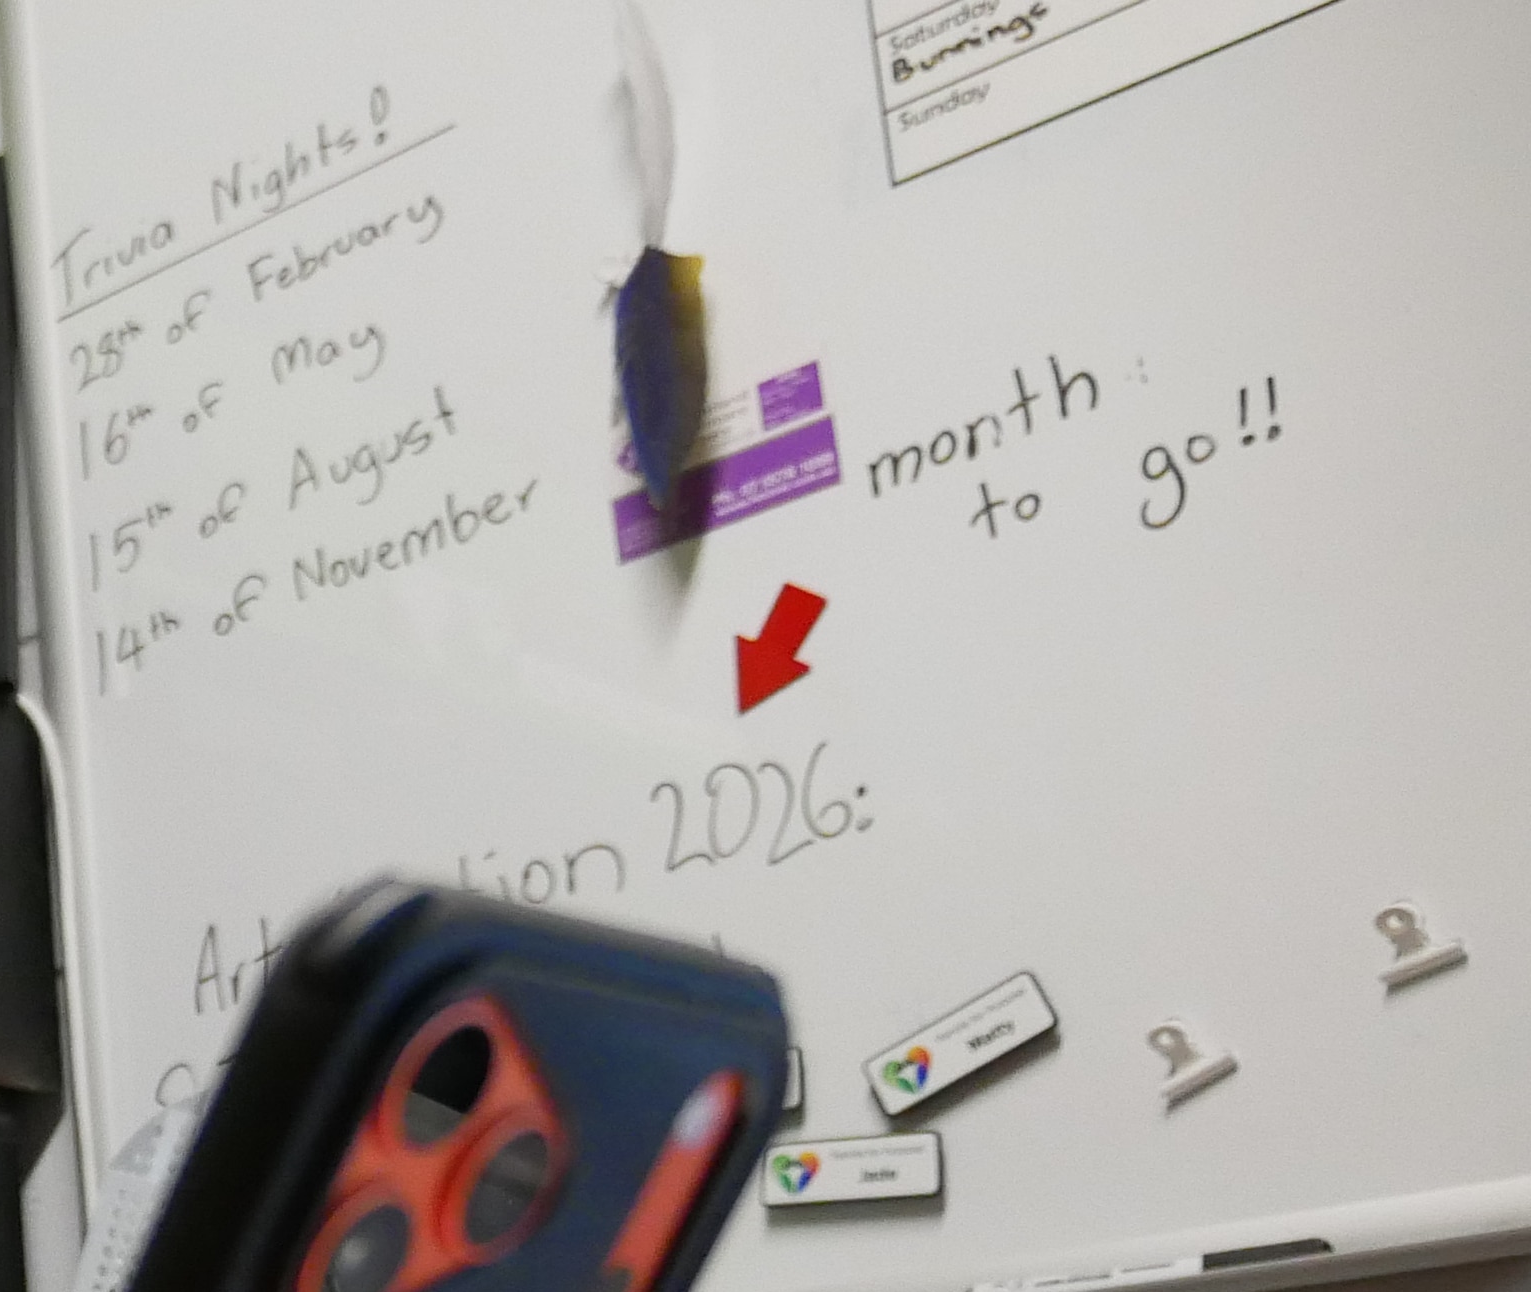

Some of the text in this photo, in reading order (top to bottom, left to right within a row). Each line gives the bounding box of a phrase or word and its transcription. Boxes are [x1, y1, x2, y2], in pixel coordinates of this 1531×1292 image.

[898, 83, 991, 132] Sunday
[50, 85, 391, 307] Trivia Nights!
[69, 194, 444, 393] 28th of February
[78, 323, 386, 481] 16th of May
[867, 355, 1099, 497] month
[970, 376, 1283, 538] to go!!
[90, 384, 457, 592] 15th of August
[96, 478, 538, 697] 14th of November
[650, 741, 874, 873] 2026:
